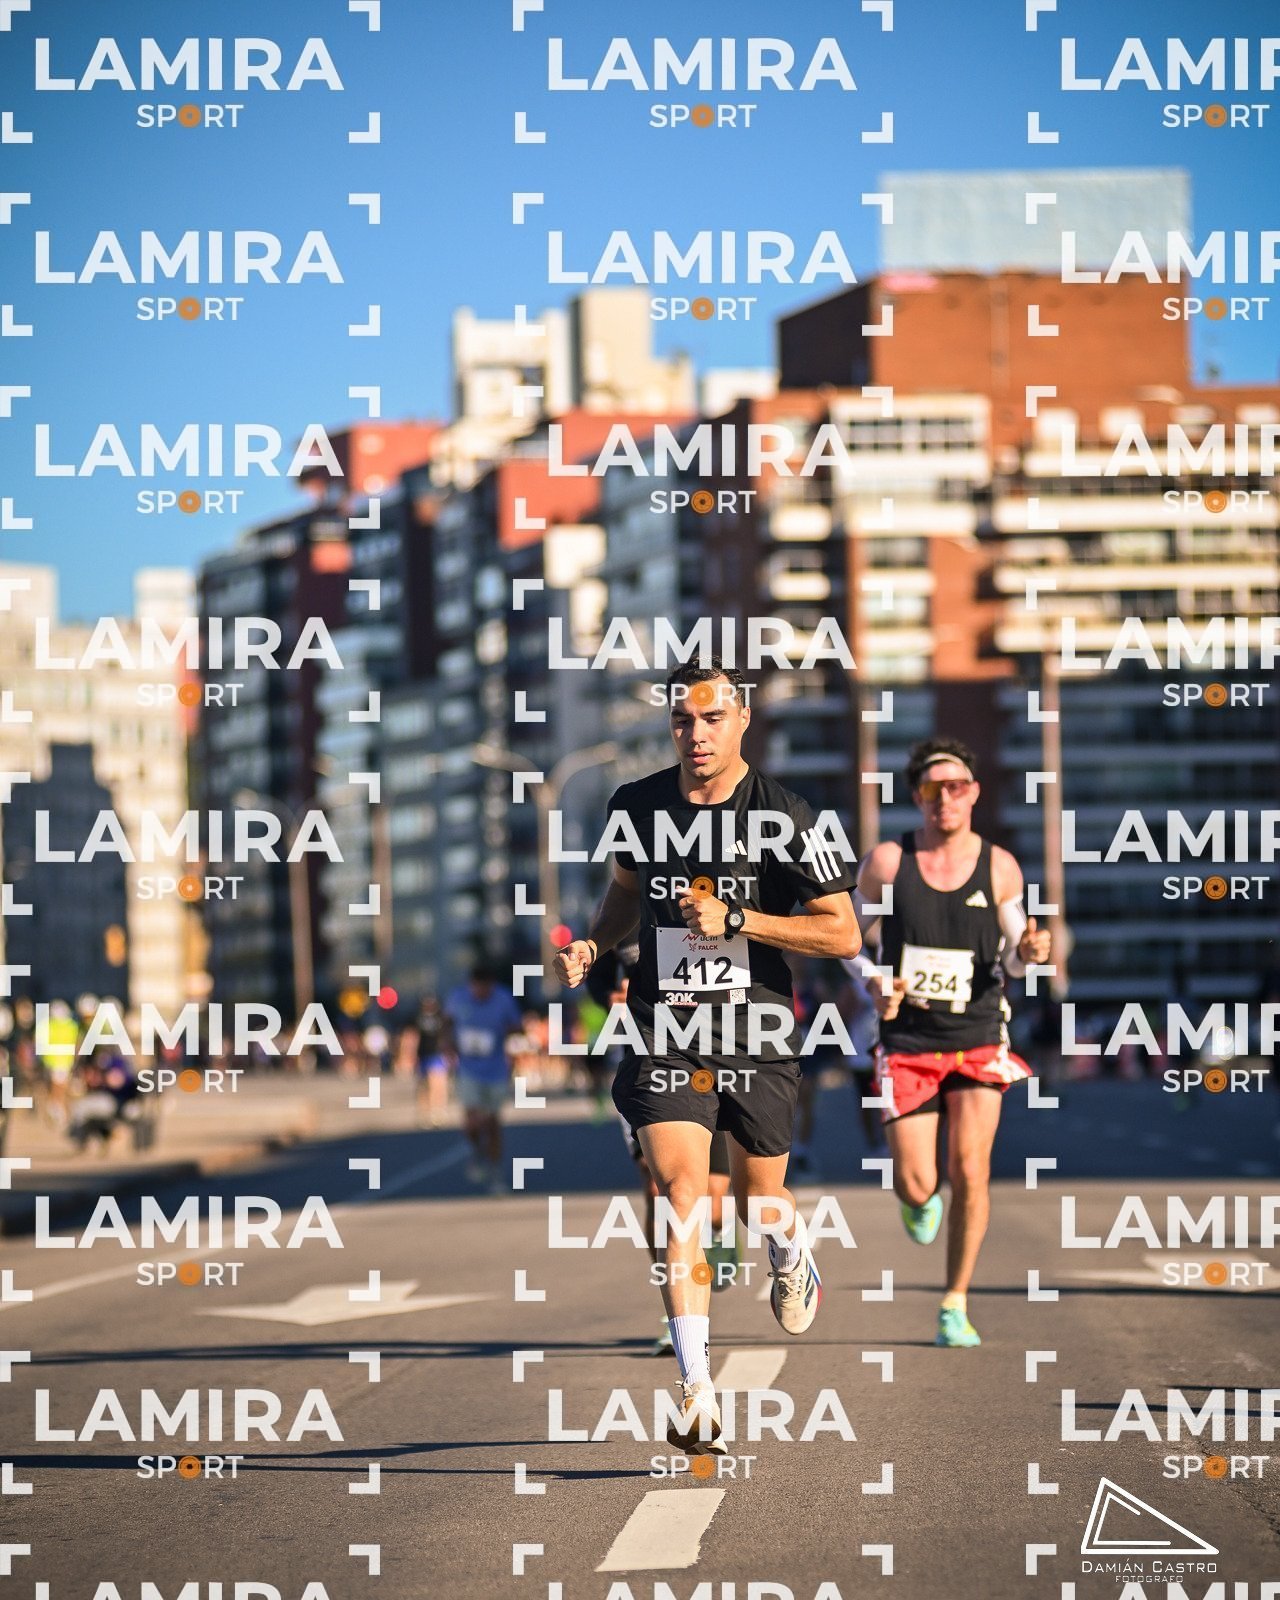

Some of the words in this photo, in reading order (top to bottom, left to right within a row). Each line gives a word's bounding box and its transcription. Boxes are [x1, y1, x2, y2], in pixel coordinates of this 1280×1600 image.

[673, 956, 733, 985] 412
[913, 970, 958, 994] 254
[665, 992, 695, 1005] 30K
